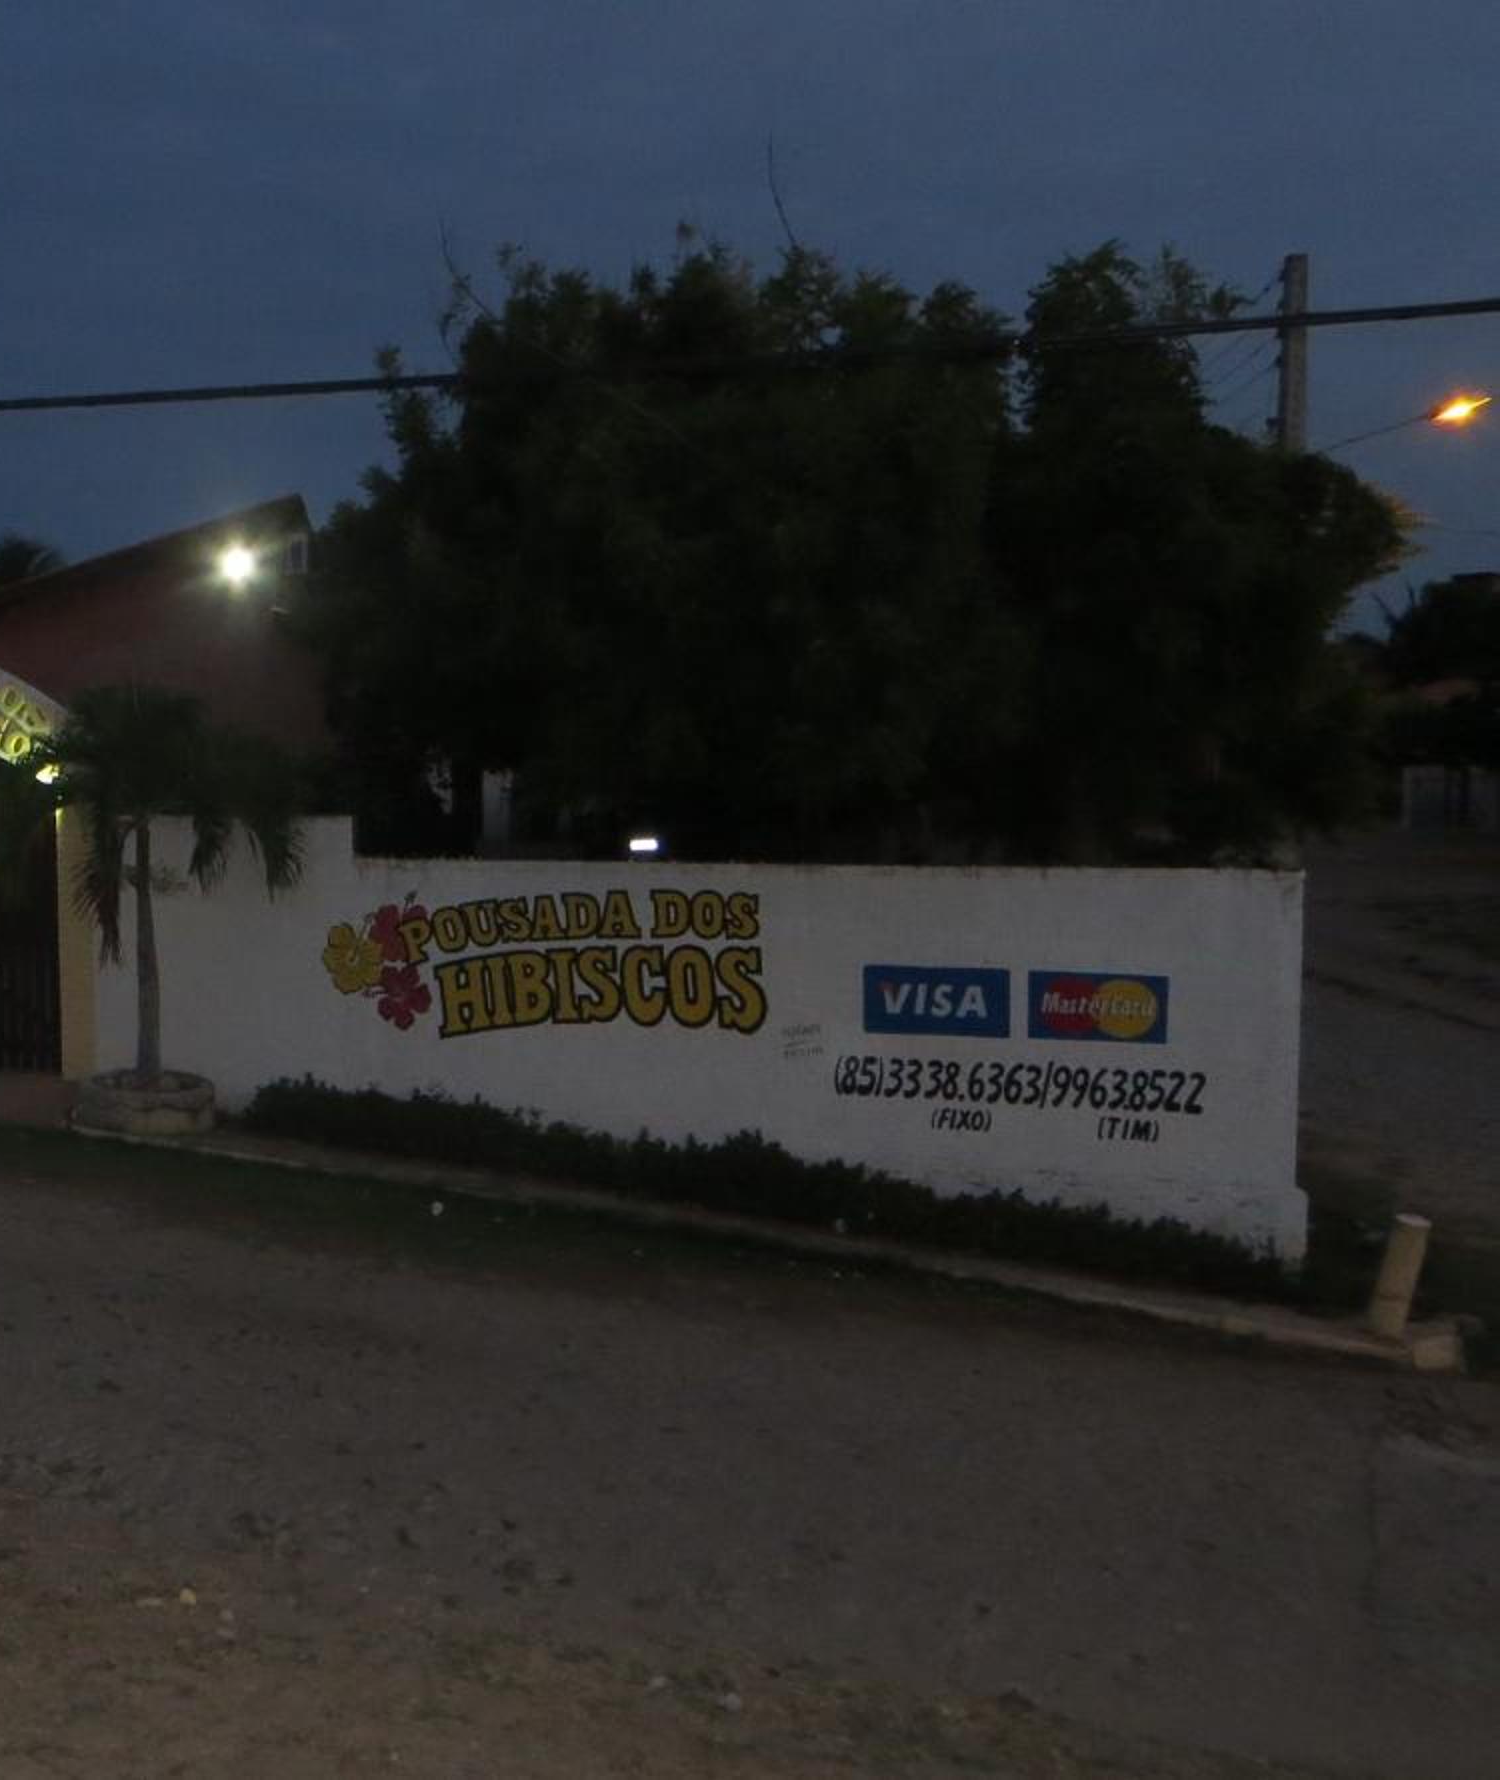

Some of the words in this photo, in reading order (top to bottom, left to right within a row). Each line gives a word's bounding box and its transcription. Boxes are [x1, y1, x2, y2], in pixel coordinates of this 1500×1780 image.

[398, 889, 641, 967] POUSADA
[650, 888, 760, 939] DOS
[434, 944, 769, 1040] HIBISCOS
[880, 981, 989, 1020] VISA
[1041, 991, 1157, 1018] MasterCard
[931, 1107, 992, 1132] (FIXO)
[1097, 1117, 1160, 1142] (TIM)
